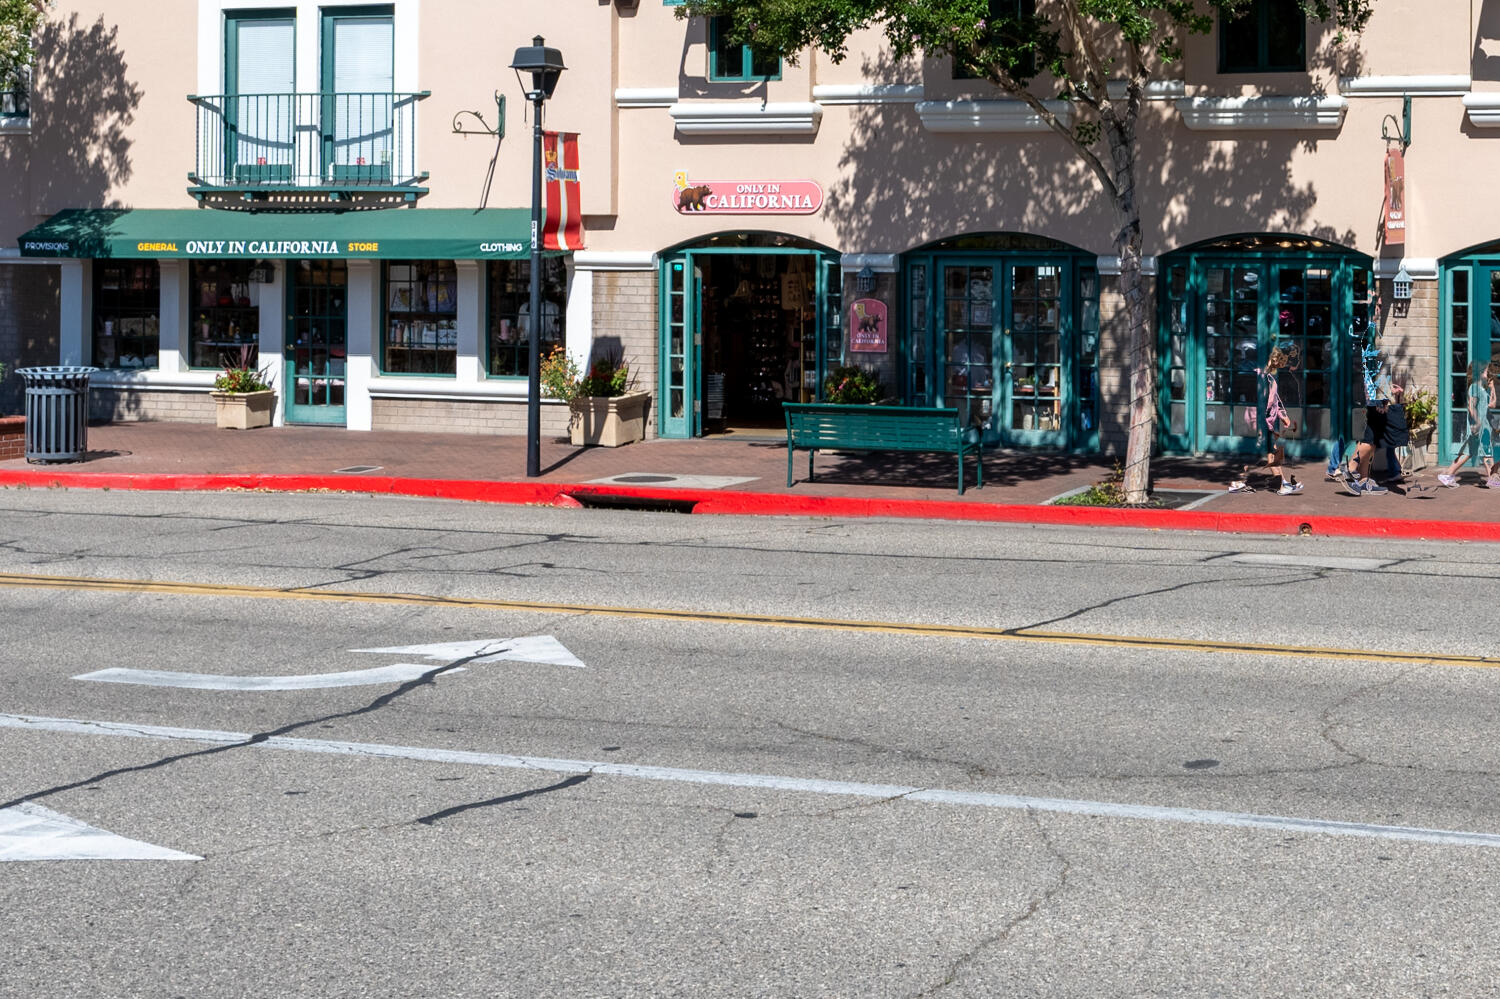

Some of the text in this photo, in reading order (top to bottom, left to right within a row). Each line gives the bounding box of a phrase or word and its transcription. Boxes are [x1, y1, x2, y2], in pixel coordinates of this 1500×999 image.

[545, 162, 578, 183] Solvang
[736, 184, 780, 194] ONLY IN
[706, 194, 813, 209] CALIFORNIA
[25, 242, 69, 250] PROVISIONS
[137, 241, 379, 254] GENERAL ONLY IN CALIFORNIA STORE
[480, 243, 523, 252] CLOTHING
